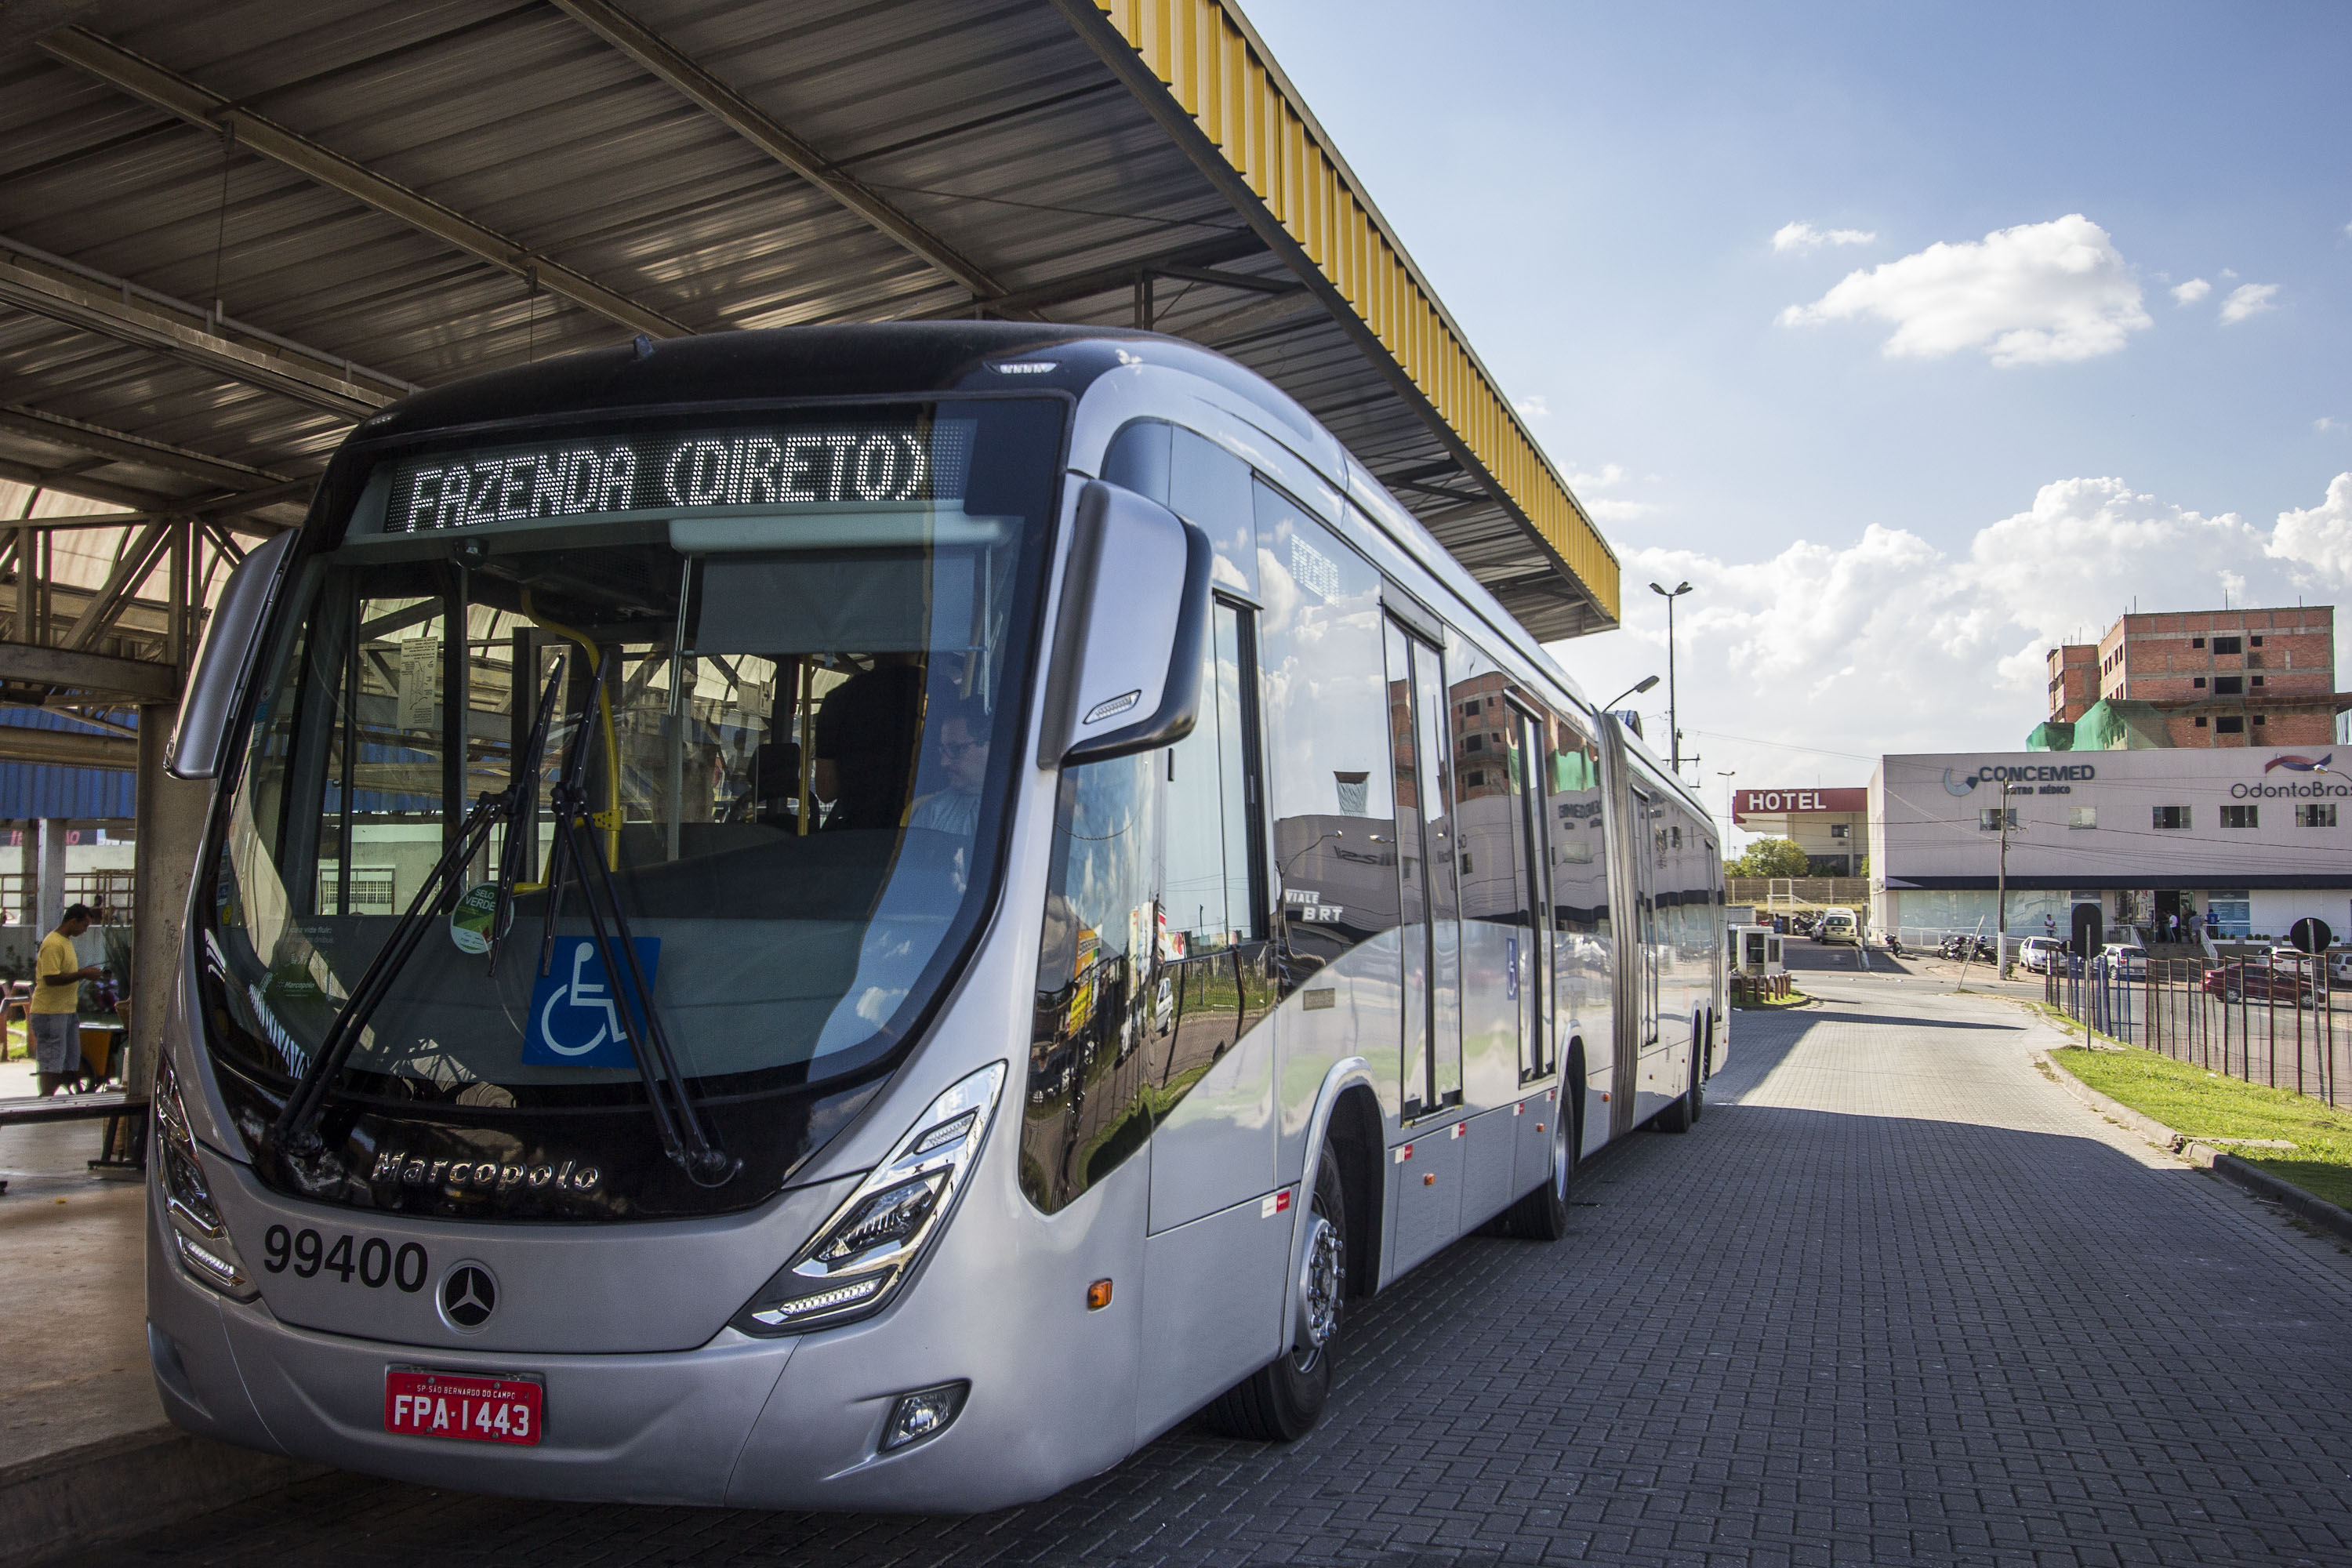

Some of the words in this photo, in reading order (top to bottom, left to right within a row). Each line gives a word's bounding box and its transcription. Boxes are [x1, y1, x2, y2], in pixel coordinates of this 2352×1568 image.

[406, 446, 637, 533] FAZENDA
[664, 434, 925, 506] (DIRETO)
[1979, 765, 2095, 782] CONCEMED
[1748, 792, 1827, 810] HOTEL
[475, 888, 495, 899] SELO
[1285, 888, 1319, 904] VIALE
[466, 895, 495, 911] VERDE
[1302, 905, 1344, 922] BRT
[371, 1152, 601, 1192] Marcopolo
[263, 1225, 428, 1293] 99400
[444, 1386, 481, 1397] BERNARDO
[481, 1389, 492, 1398] DO
[492, 1391, 516, 1400] CAMPO
